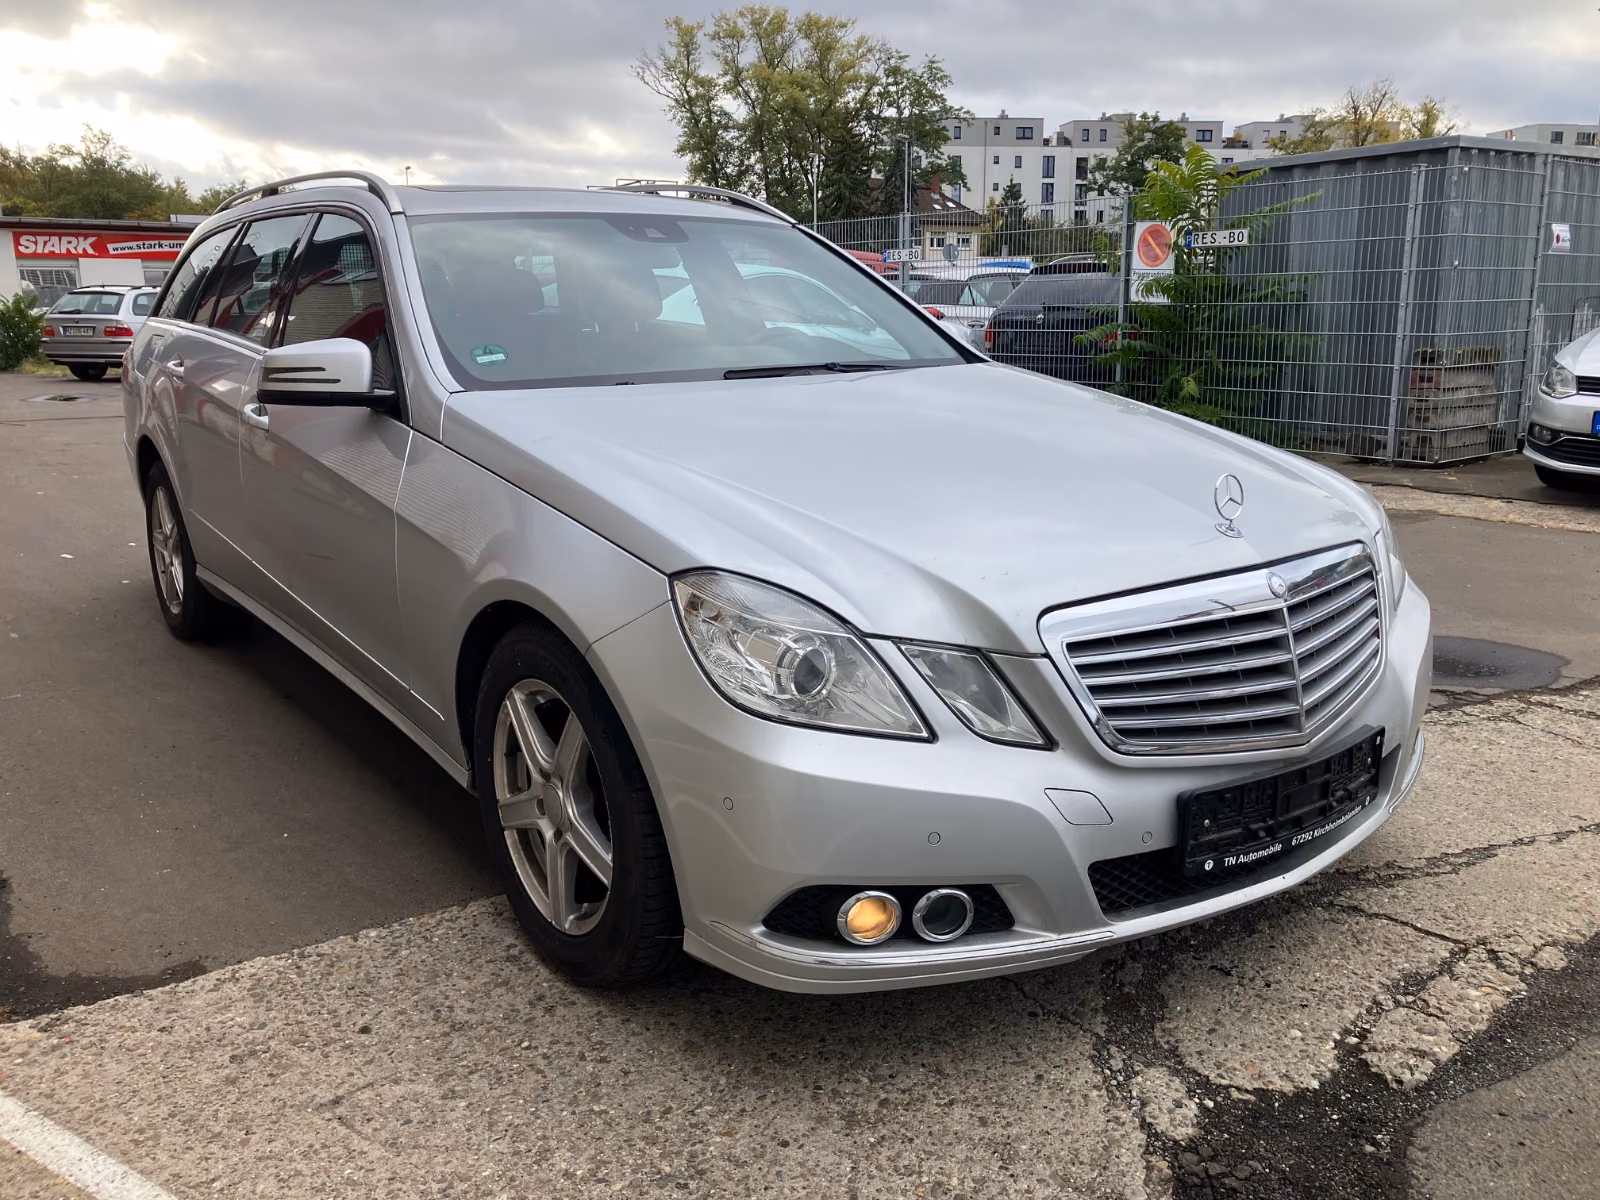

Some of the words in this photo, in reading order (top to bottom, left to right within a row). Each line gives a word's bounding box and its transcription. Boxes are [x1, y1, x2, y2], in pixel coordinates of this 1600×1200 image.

[18, 235, 98, 254] STARK
[1291, 831, 1313, 846] 67292
[1224, 856, 1236, 867] TN
[1237, 843, 1282, 864] Automobile
